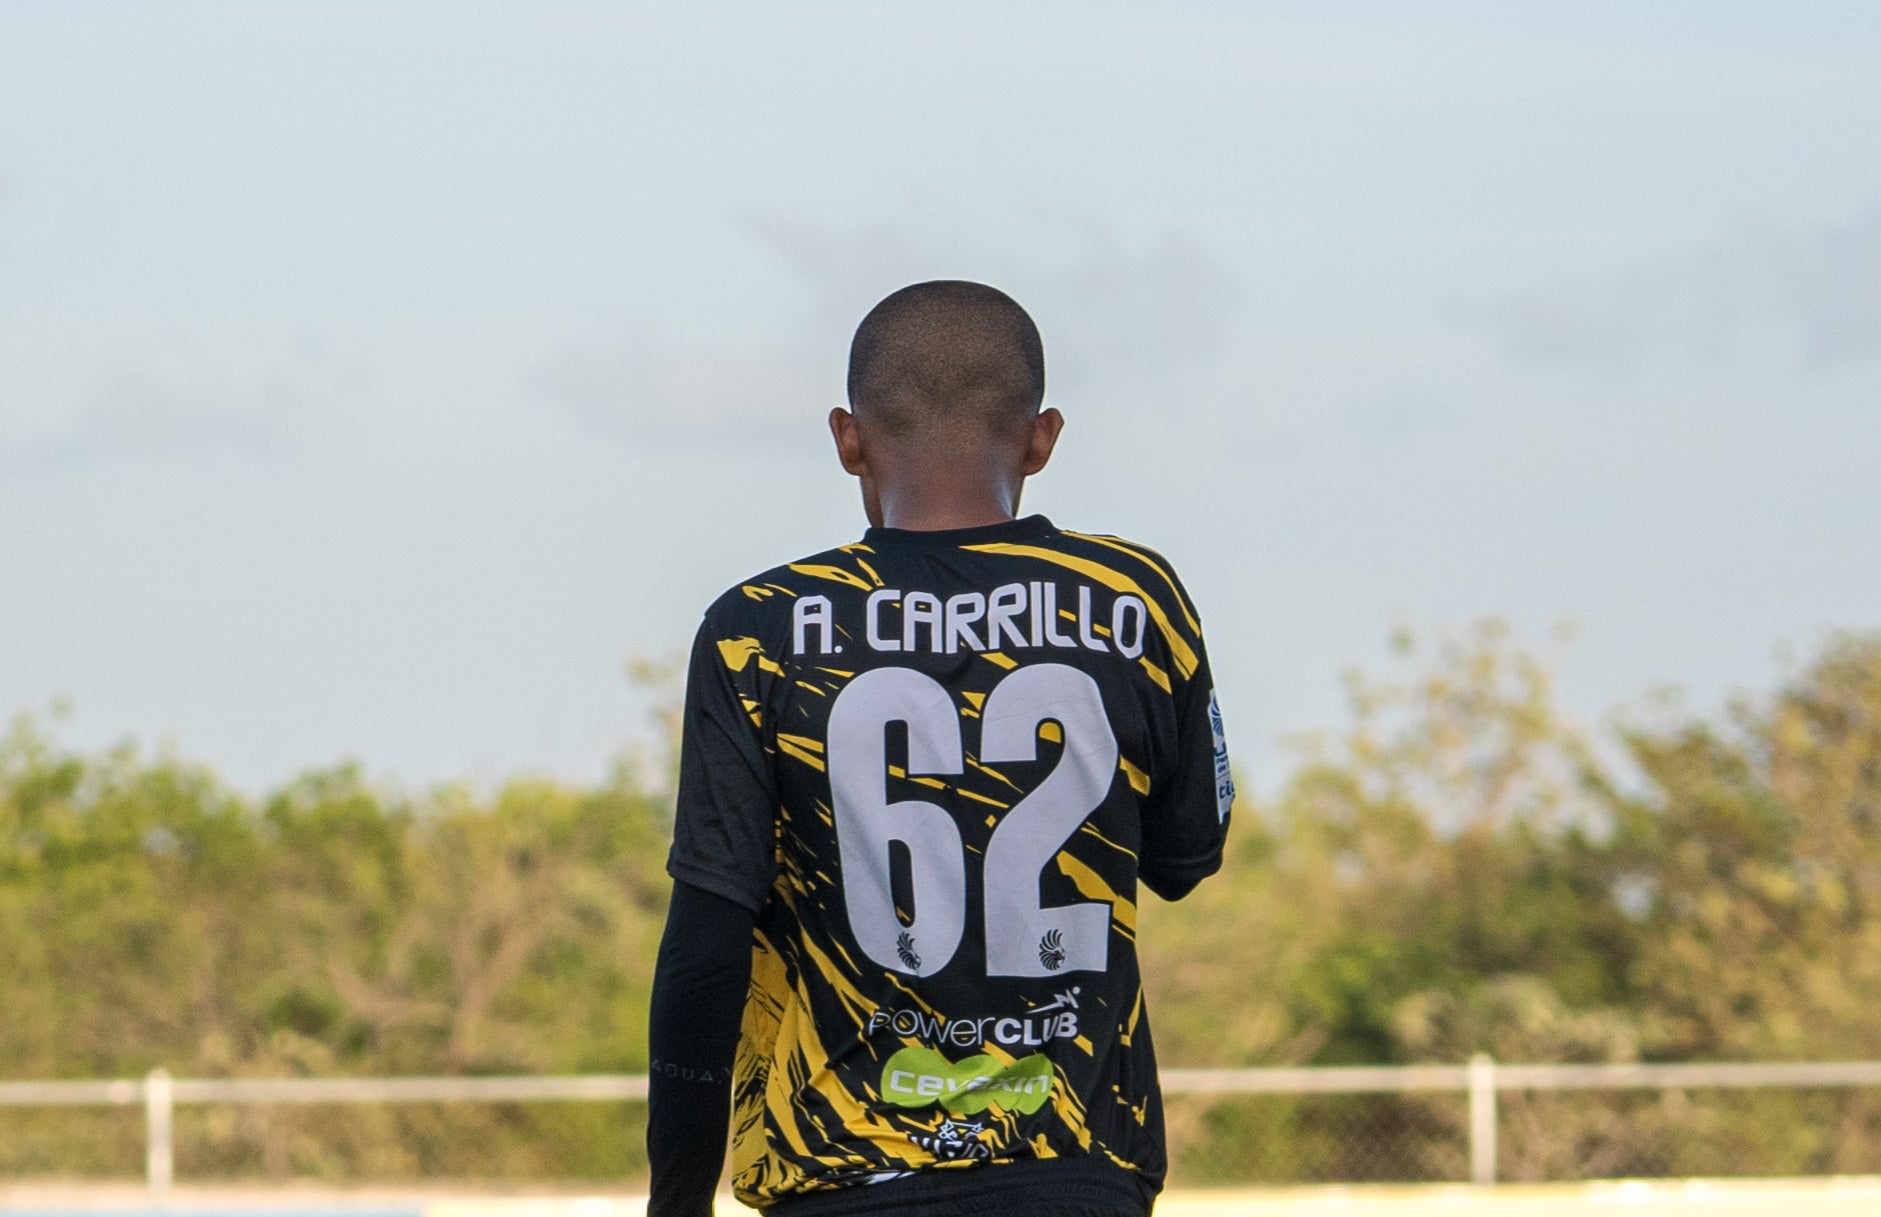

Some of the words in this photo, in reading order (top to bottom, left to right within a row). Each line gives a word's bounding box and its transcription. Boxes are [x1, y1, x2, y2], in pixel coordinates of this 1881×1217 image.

[793, 595, 843, 655] A.
[866, 582, 1146, 659] CARRILLO
[827, 663, 1118, 978] 62
